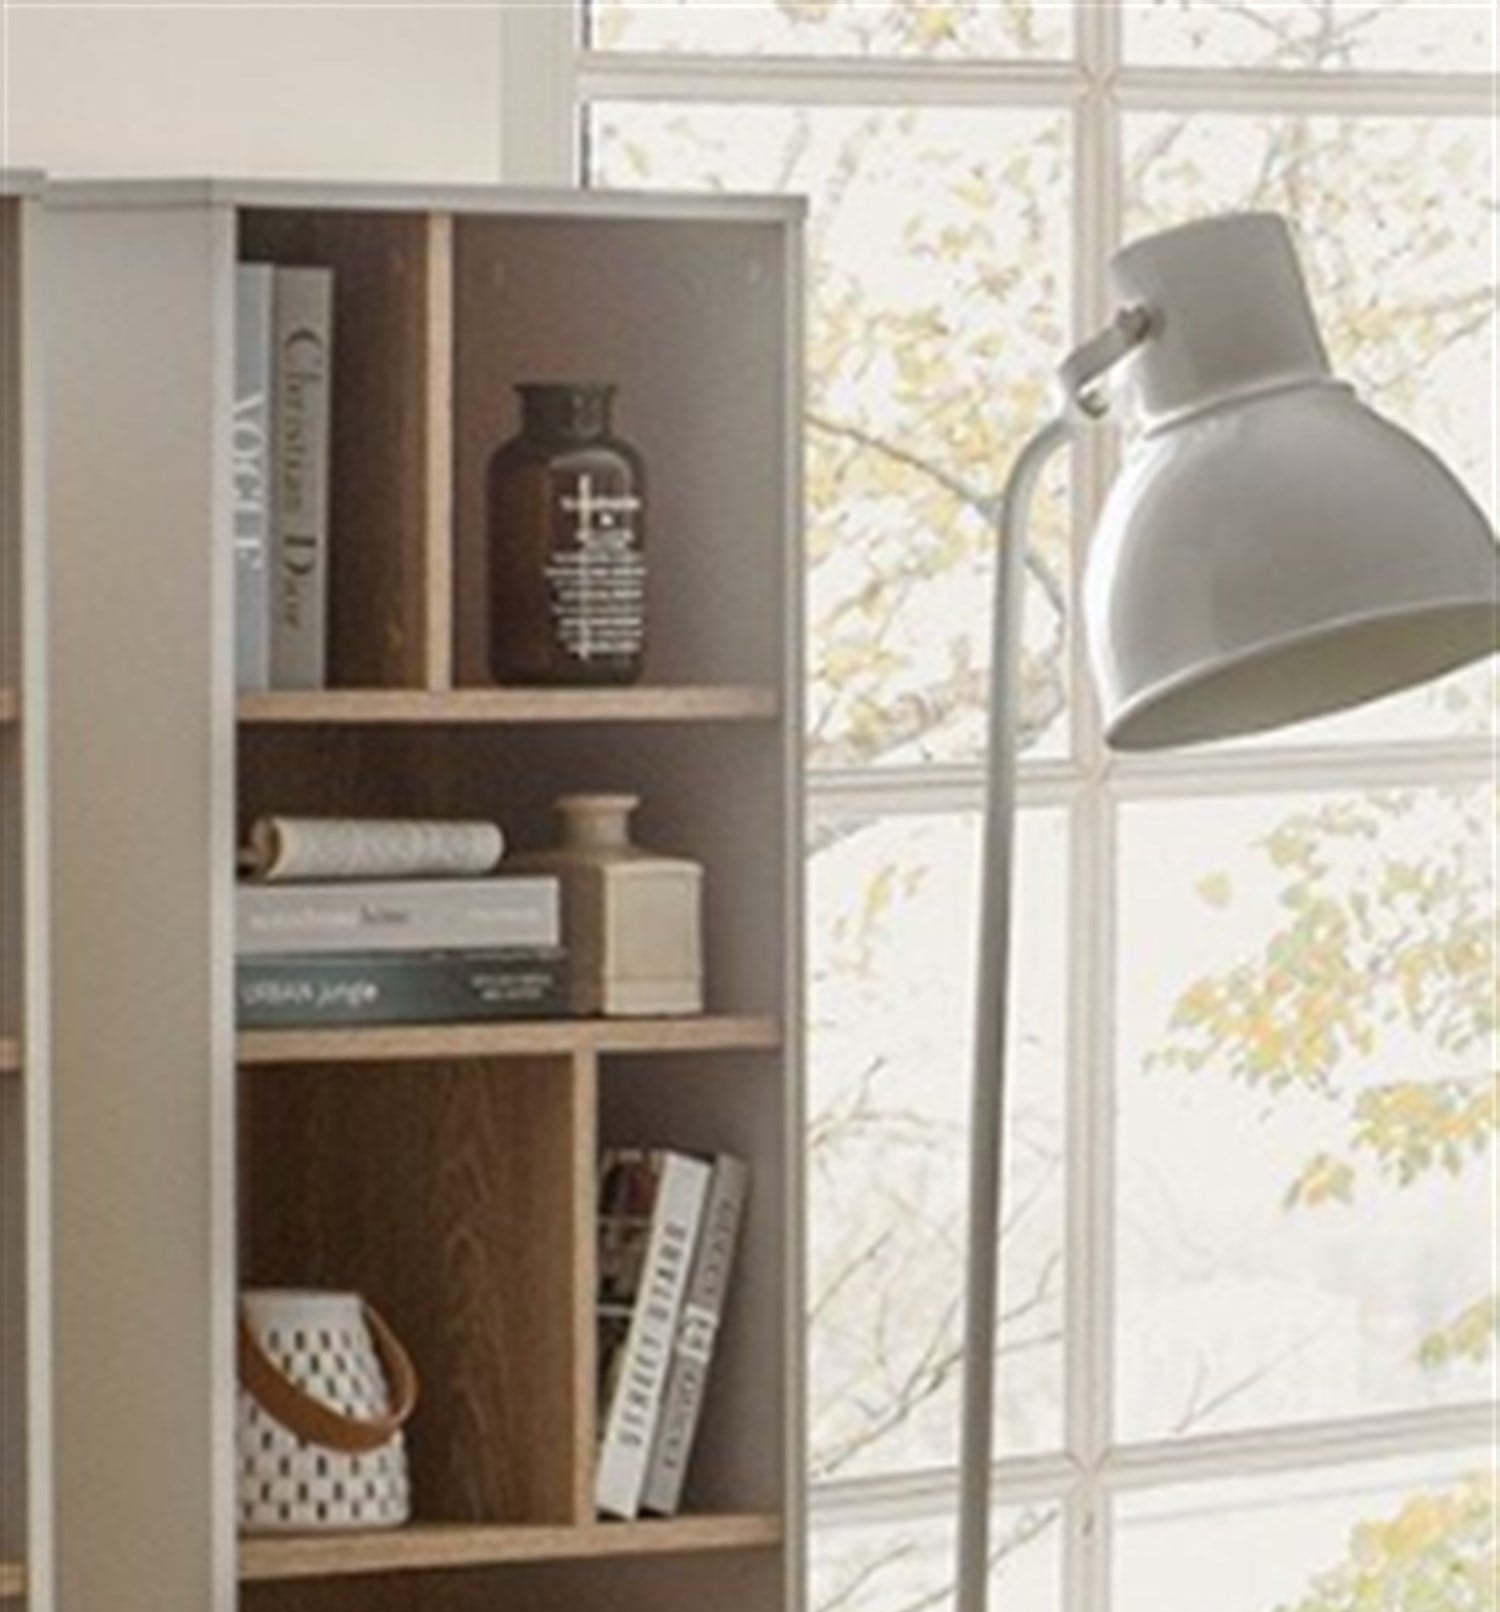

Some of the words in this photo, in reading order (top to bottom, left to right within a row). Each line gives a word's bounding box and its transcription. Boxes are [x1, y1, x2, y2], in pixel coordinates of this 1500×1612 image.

[233, 393, 265, 571] VOGUE
[284, 327, 324, 513] Christian
[283, 536, 318, 630] Dior
